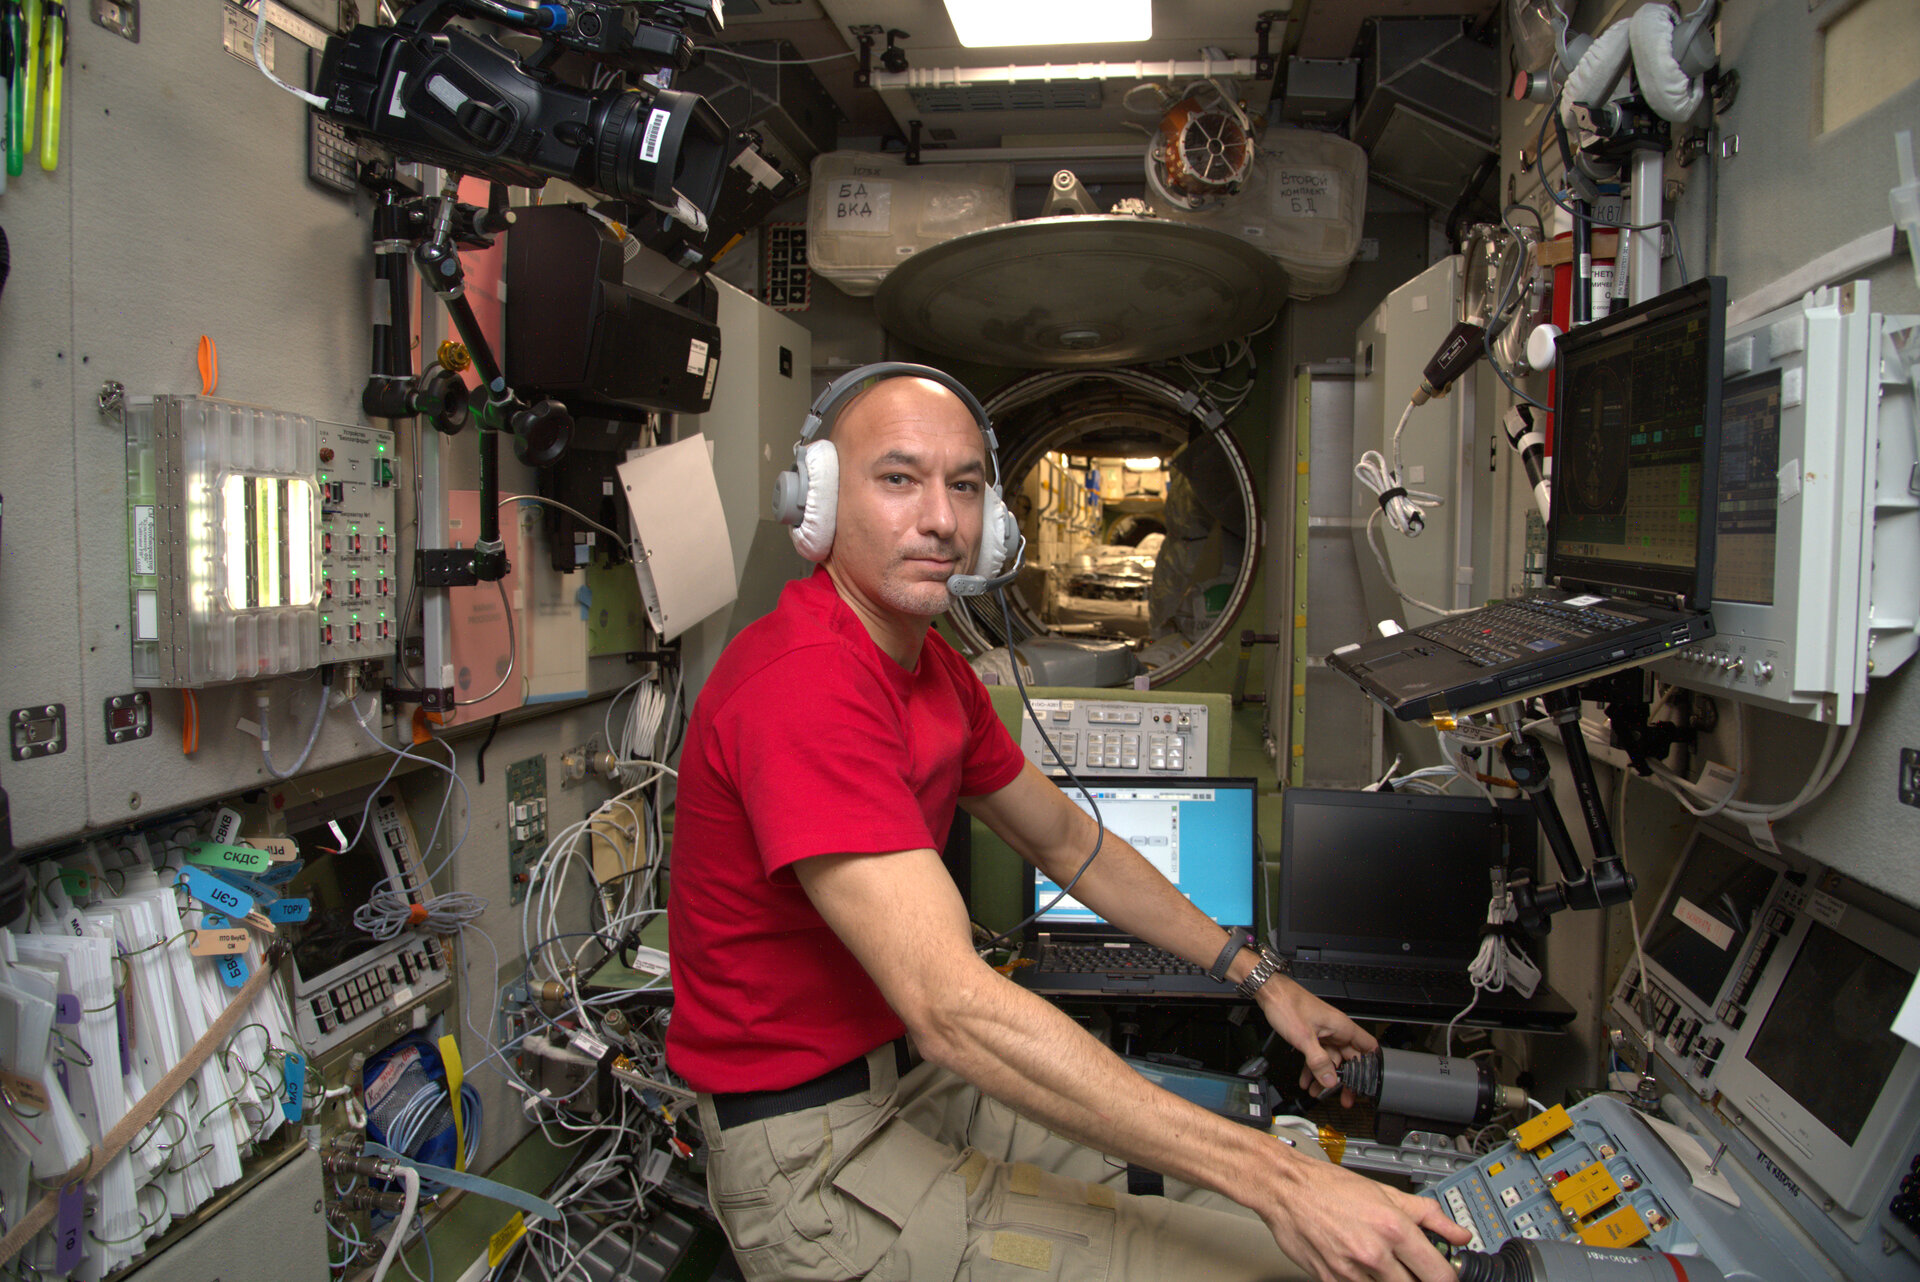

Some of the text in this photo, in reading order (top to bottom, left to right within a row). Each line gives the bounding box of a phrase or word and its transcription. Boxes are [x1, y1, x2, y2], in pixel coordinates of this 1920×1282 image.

[839, 183, 868, 199] БД
[1291, 197, 1317, 213] БД
[215, 814, 232, 844] СВКВ
[223, 851, 260, 865] СКДС
[211, 887, 239, 908] СЭП
[283, 904, 304, 915] ТОРУ
